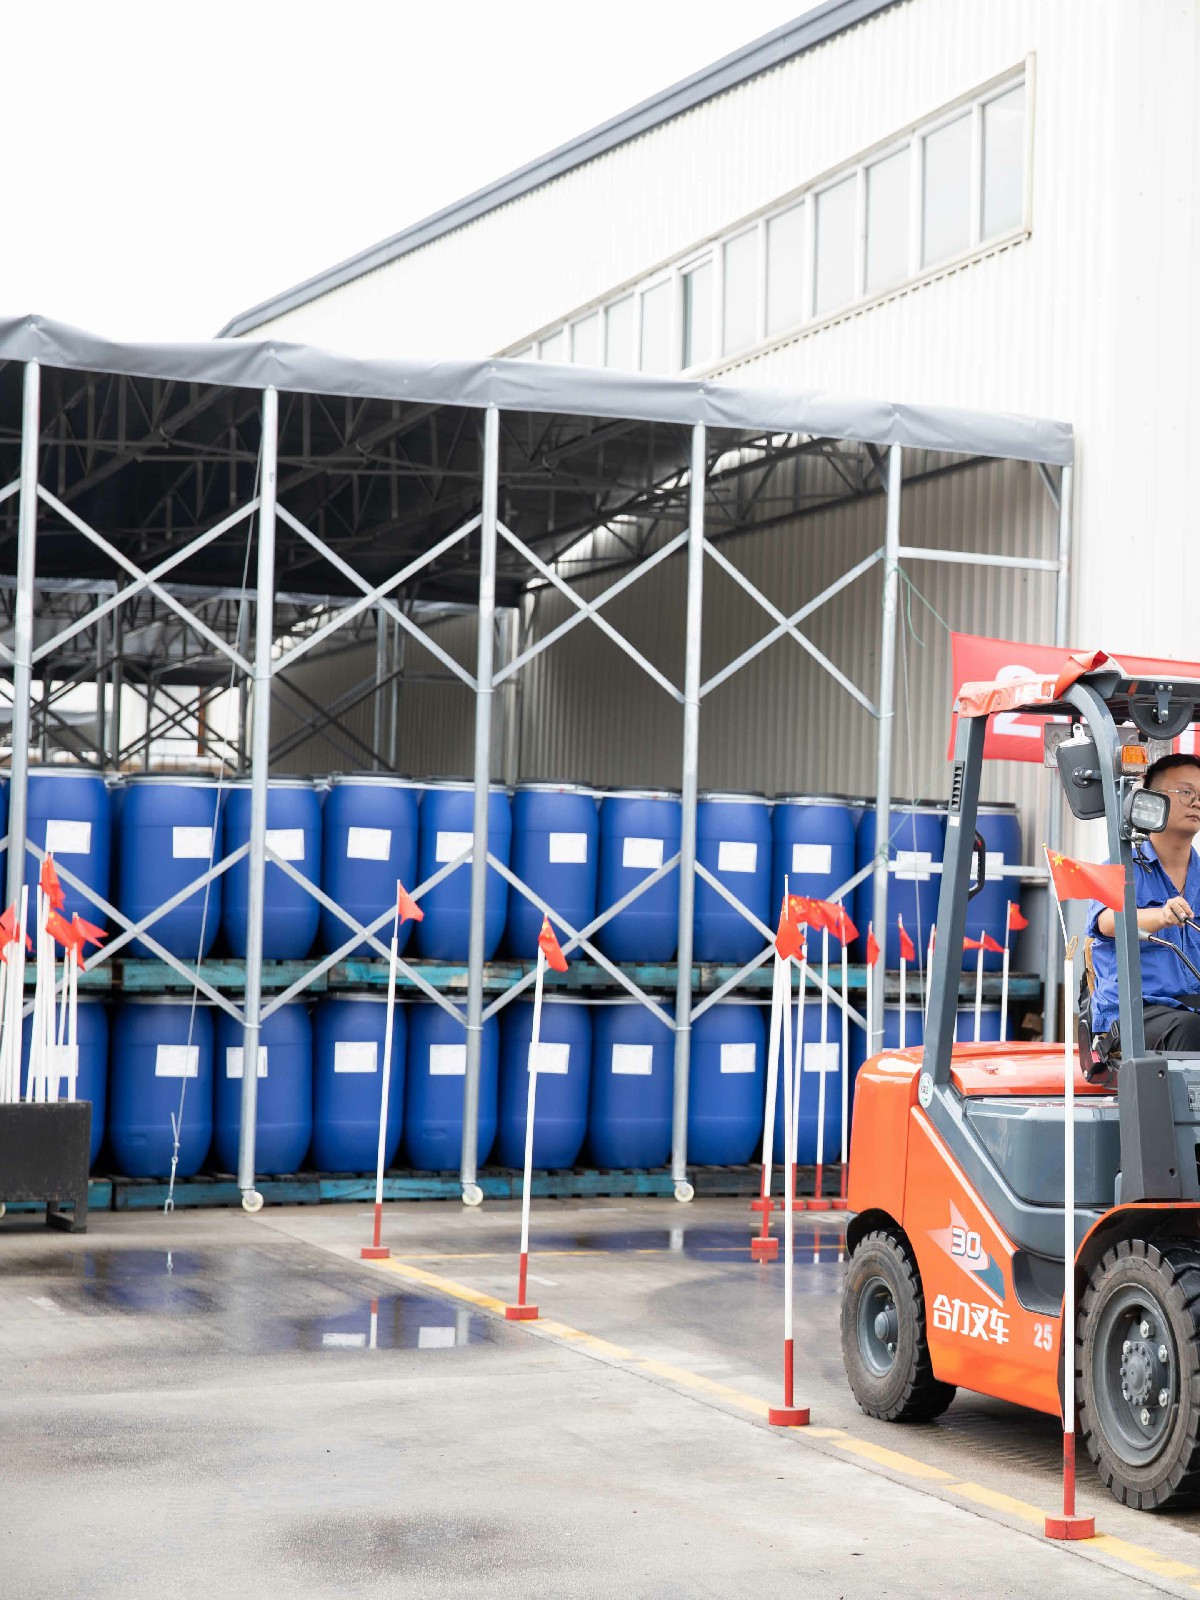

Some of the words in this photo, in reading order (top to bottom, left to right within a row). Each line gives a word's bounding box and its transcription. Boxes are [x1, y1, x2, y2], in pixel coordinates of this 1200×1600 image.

[951, 1226, 981, 1260] 30
[932, 1294, 1011, 1345] 合力叉车
[1033, 1322, 1053, 1352] 25
